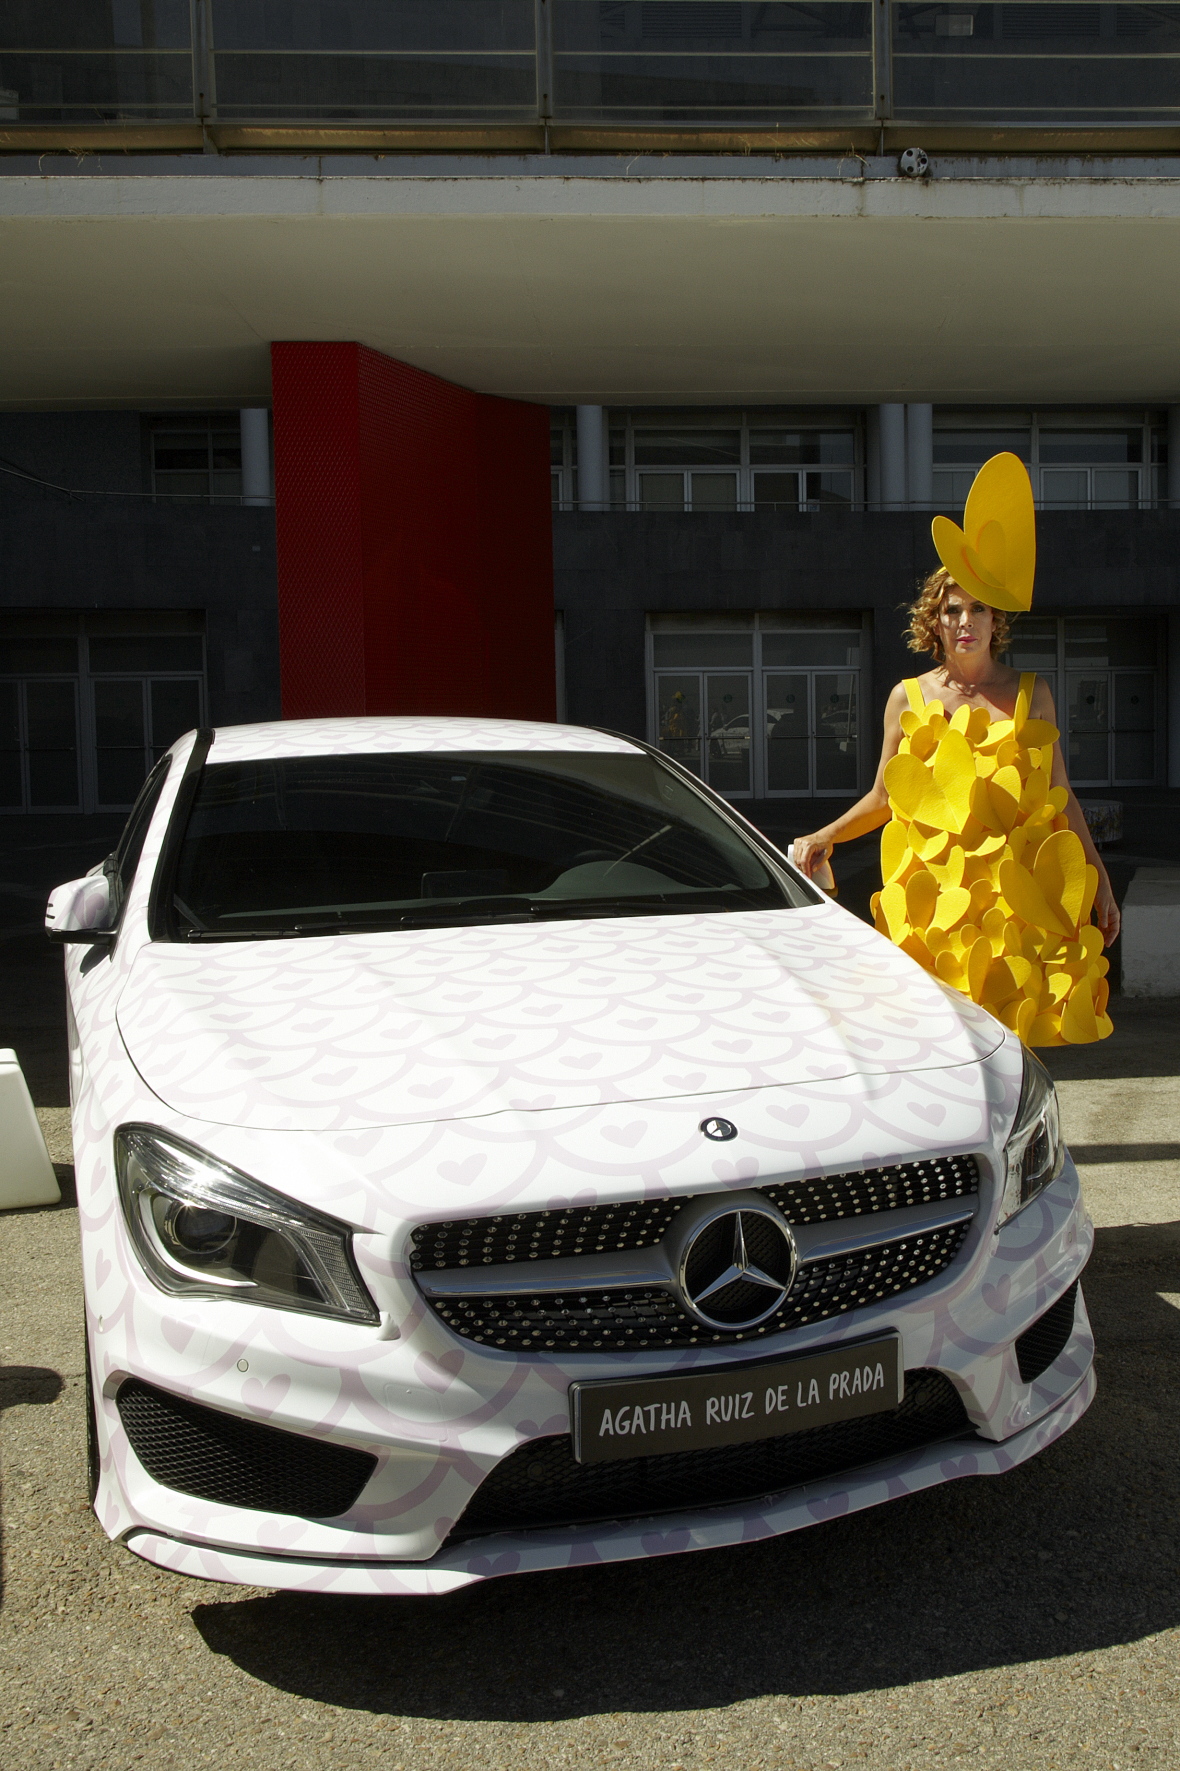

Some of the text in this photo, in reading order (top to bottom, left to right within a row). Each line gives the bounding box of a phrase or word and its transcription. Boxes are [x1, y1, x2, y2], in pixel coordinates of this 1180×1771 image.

[599, 1363, 884, 1437] AGATHA RUIZ DE LA PRADA
